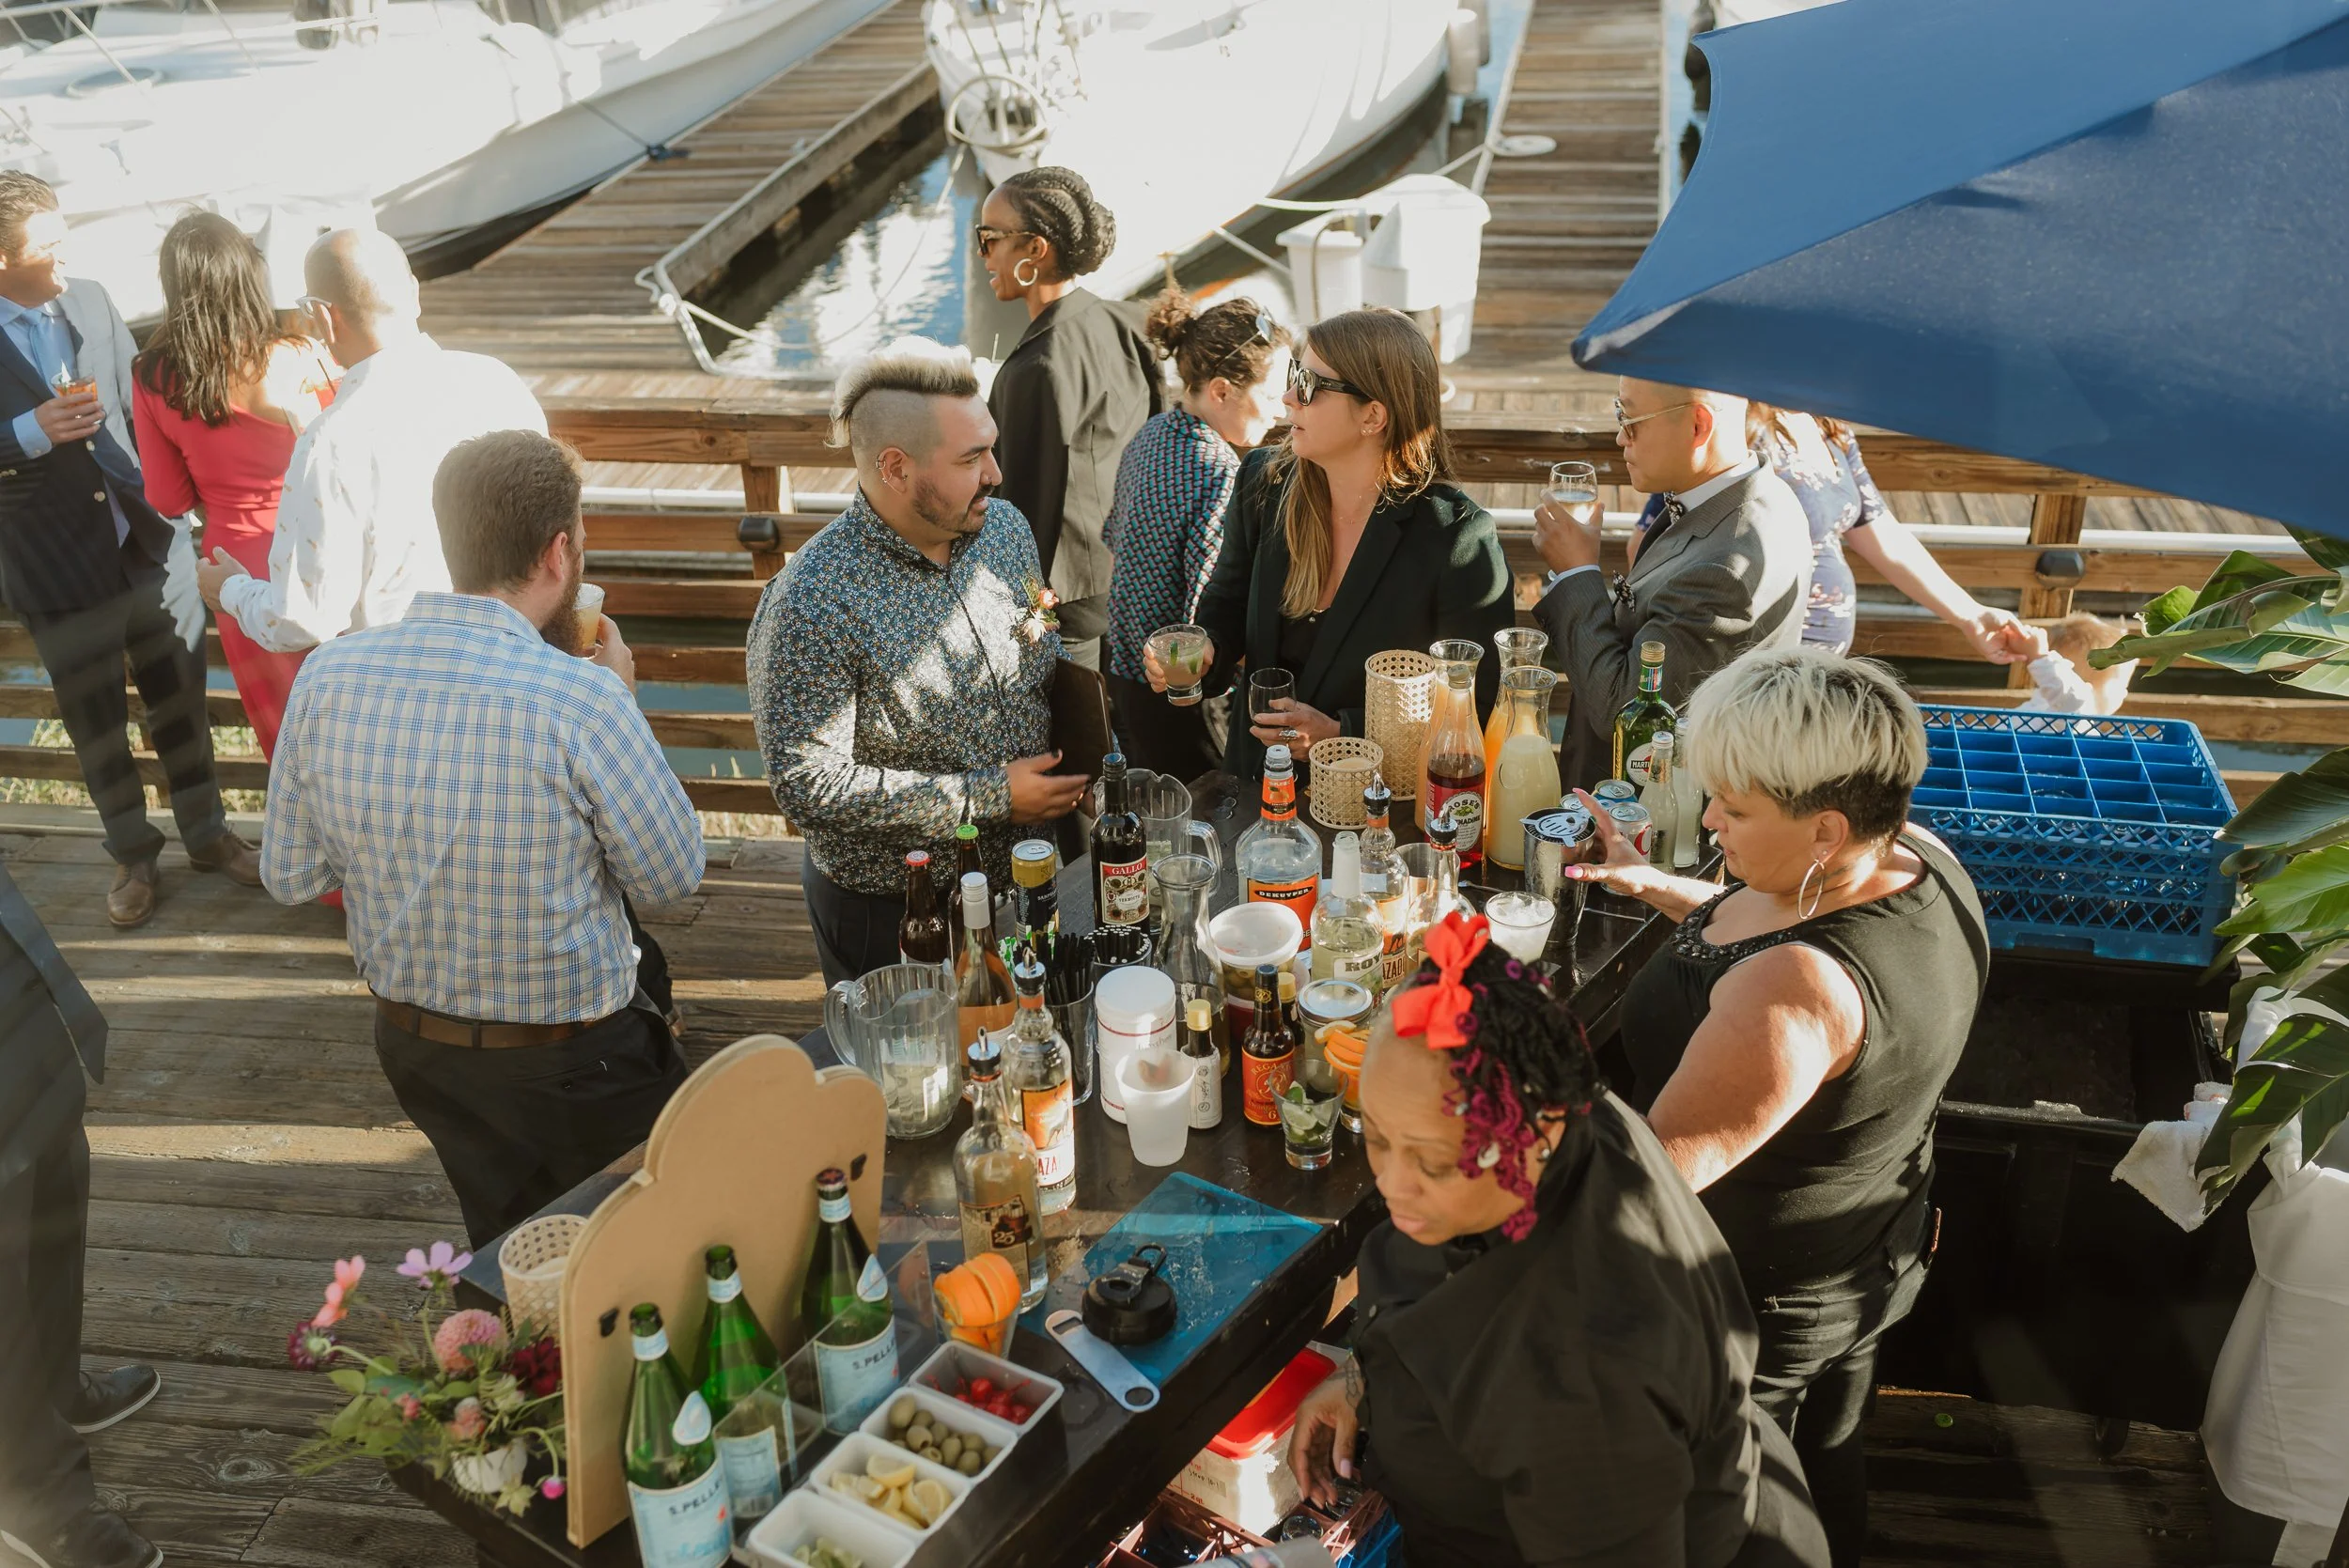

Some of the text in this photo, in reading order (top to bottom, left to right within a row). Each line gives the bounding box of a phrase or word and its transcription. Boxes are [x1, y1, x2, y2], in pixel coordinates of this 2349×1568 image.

[1448, 799, 1481, 812] ROSE'S
[1112, 862, 1143, 875] GALLO
[1258, 888, 1310, 898] DEKUYPER
[1268, 1110, 1277, 1119] 6
[993, 1231, 1016, 1245] 25
